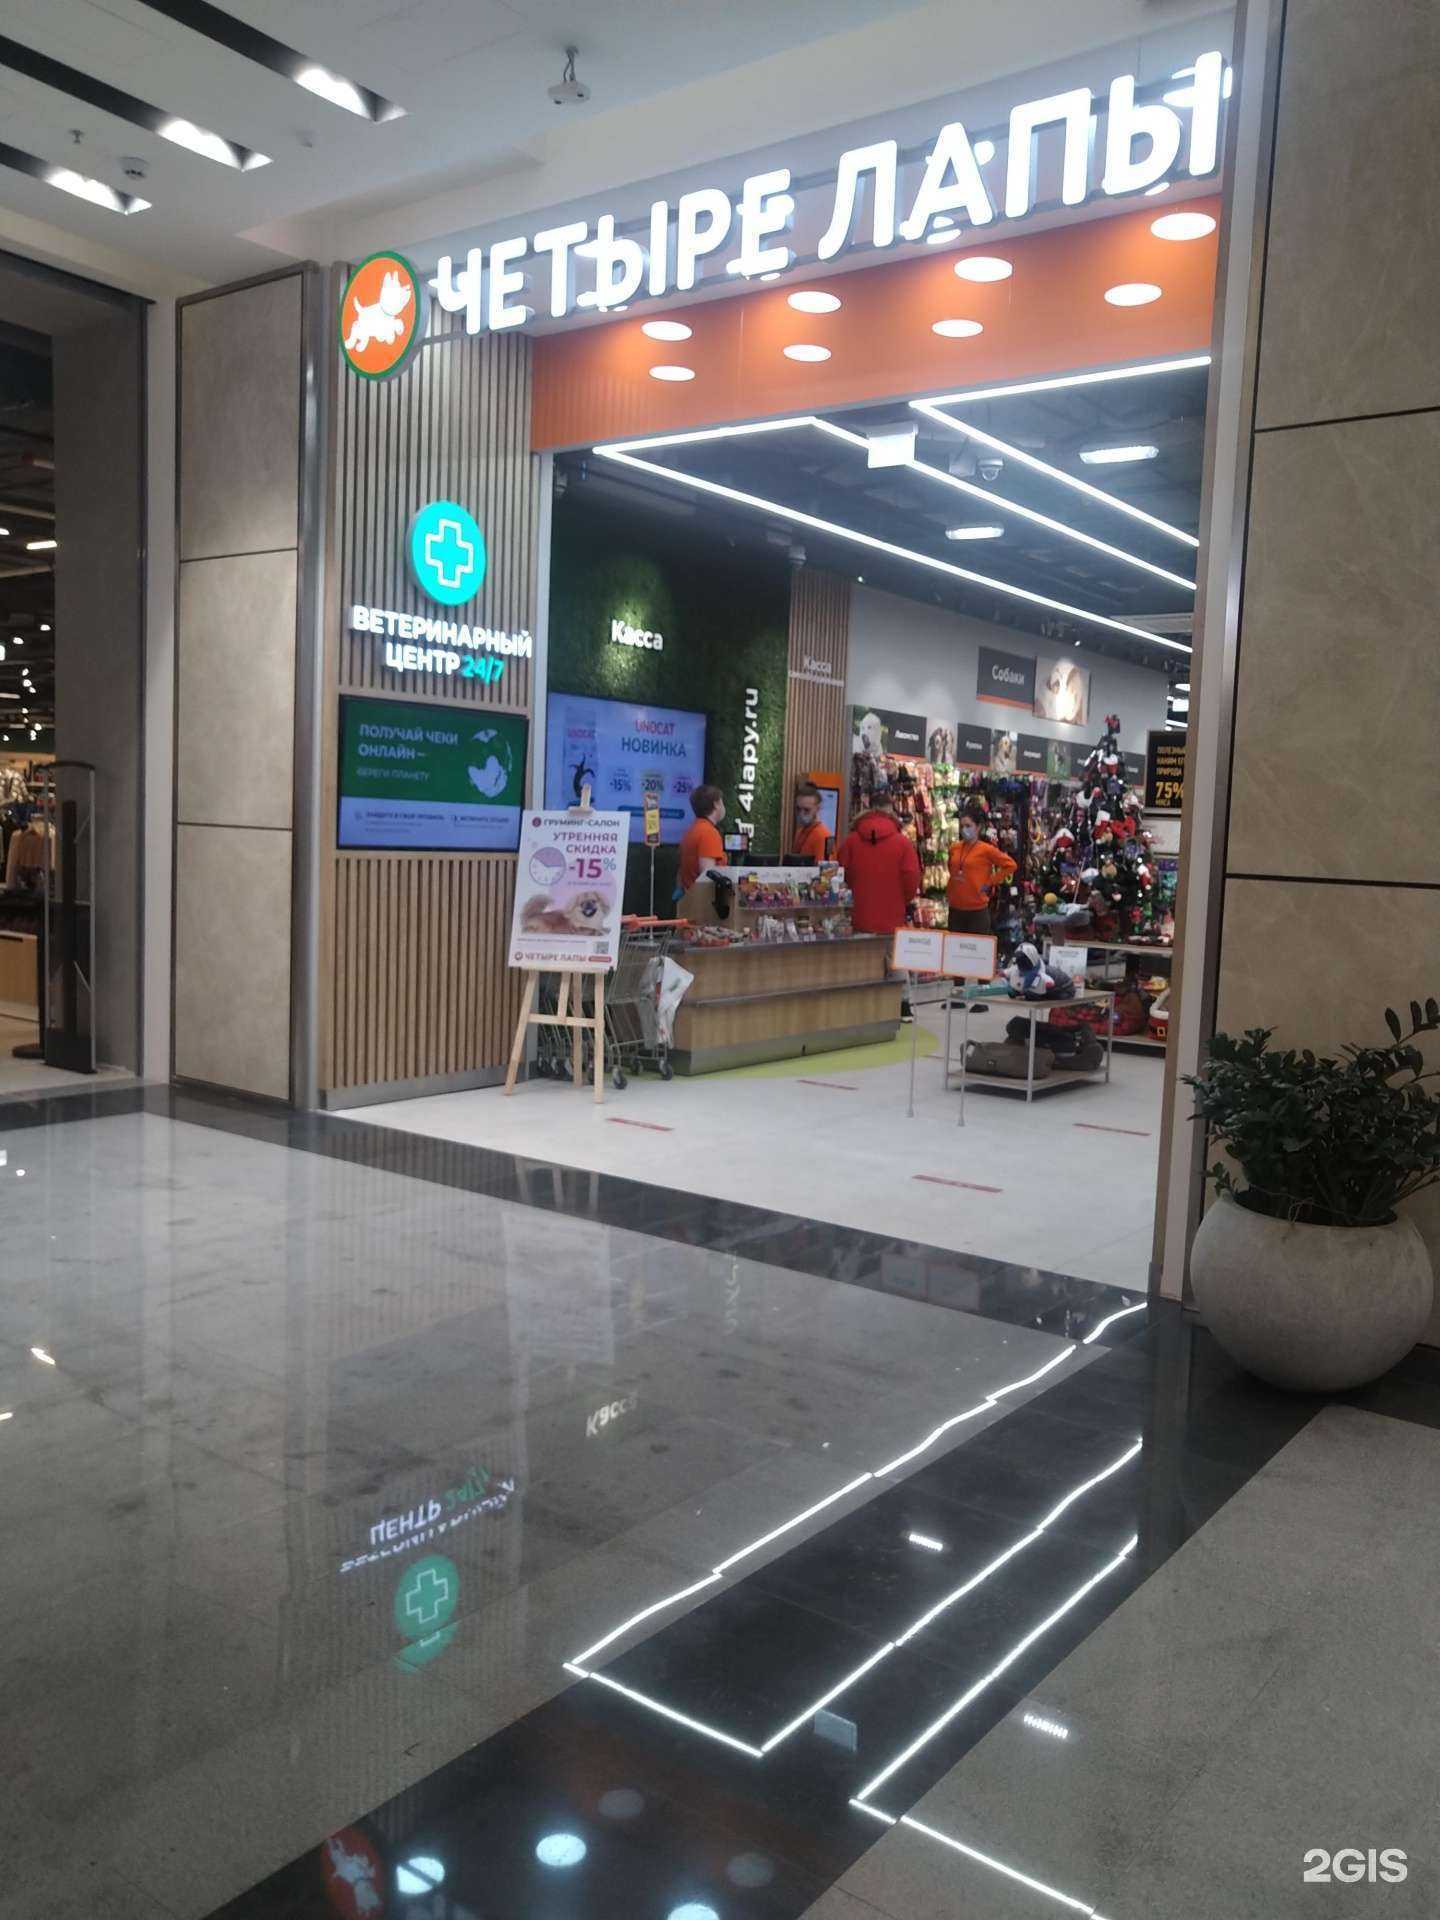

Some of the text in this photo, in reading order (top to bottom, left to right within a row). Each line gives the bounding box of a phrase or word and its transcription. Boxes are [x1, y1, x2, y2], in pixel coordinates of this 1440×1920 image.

[434, 50, 1229, 336] ЧЕТЫРЕ ЛАПЫ
[352, 604, 533, 659] ВЕТЕРИНАРНЫЙ
[611, 619, 664, 651] Касса
[385, 642, 505, 686] ЦЕНТР 24/7
[991, 664, 1025, 686] Собаки
[359, 723, 459, 745] ПОЛУЧАЙ ЧЕКИ
[358, 743, 416, 760] ОНЛАЙН
[621, 737, 687, 758] НОВИНКА
[738, 688, 759, 812] 4lapy.ru
[553, 832, 618, 843] УТРЕННЯЯ
[566, 844, 617, 855] СКИДКА
[569, 857, 617, 879] -15%
